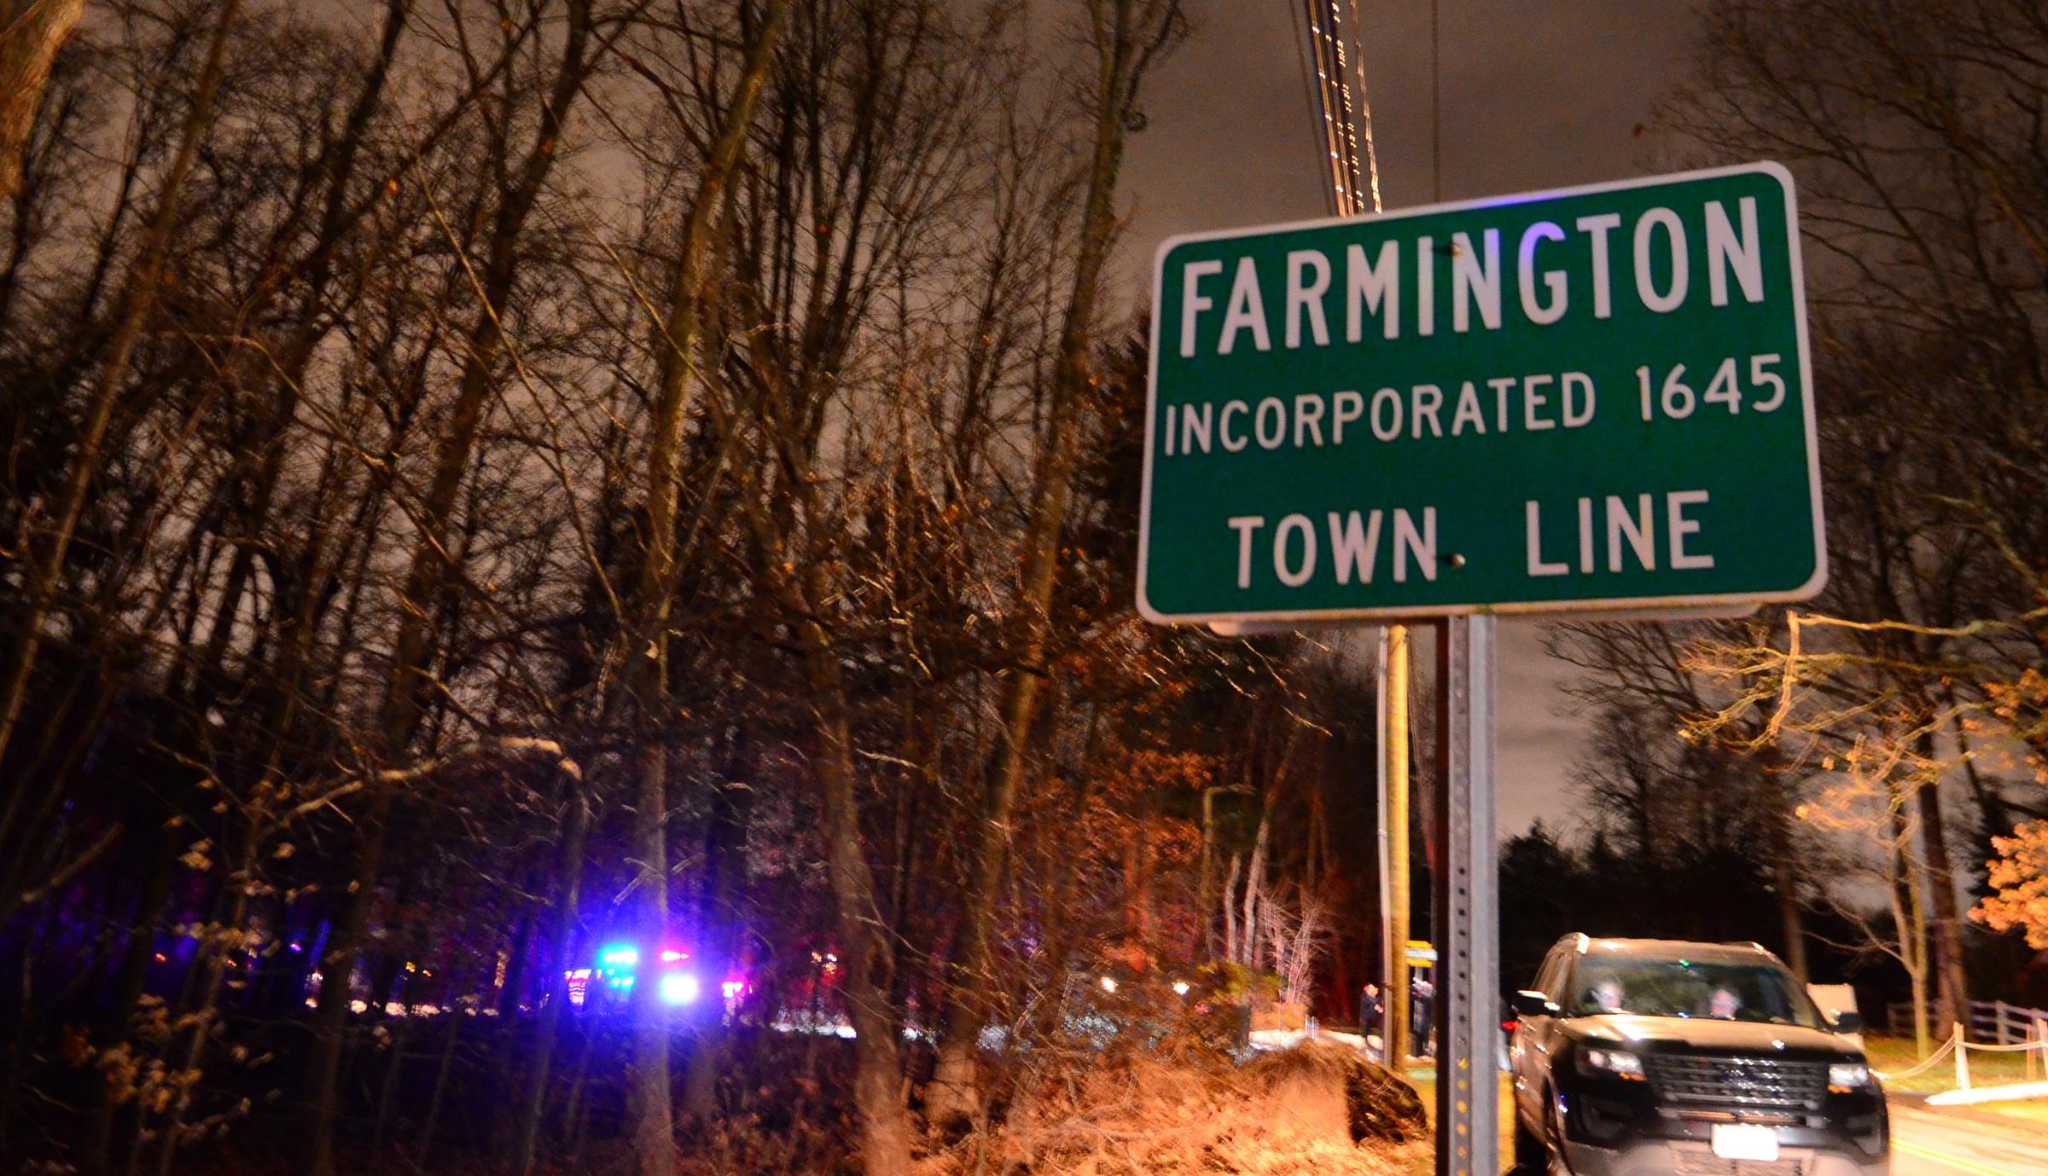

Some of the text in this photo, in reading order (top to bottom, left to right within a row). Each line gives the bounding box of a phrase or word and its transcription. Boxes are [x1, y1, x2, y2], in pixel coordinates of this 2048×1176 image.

[1180, 196, 1764, 357] FARMINGTON
[1165, 353, 1786, 456] INCORPORATED 1645
[1228, 490, 1714, 588] TOWN LINE
